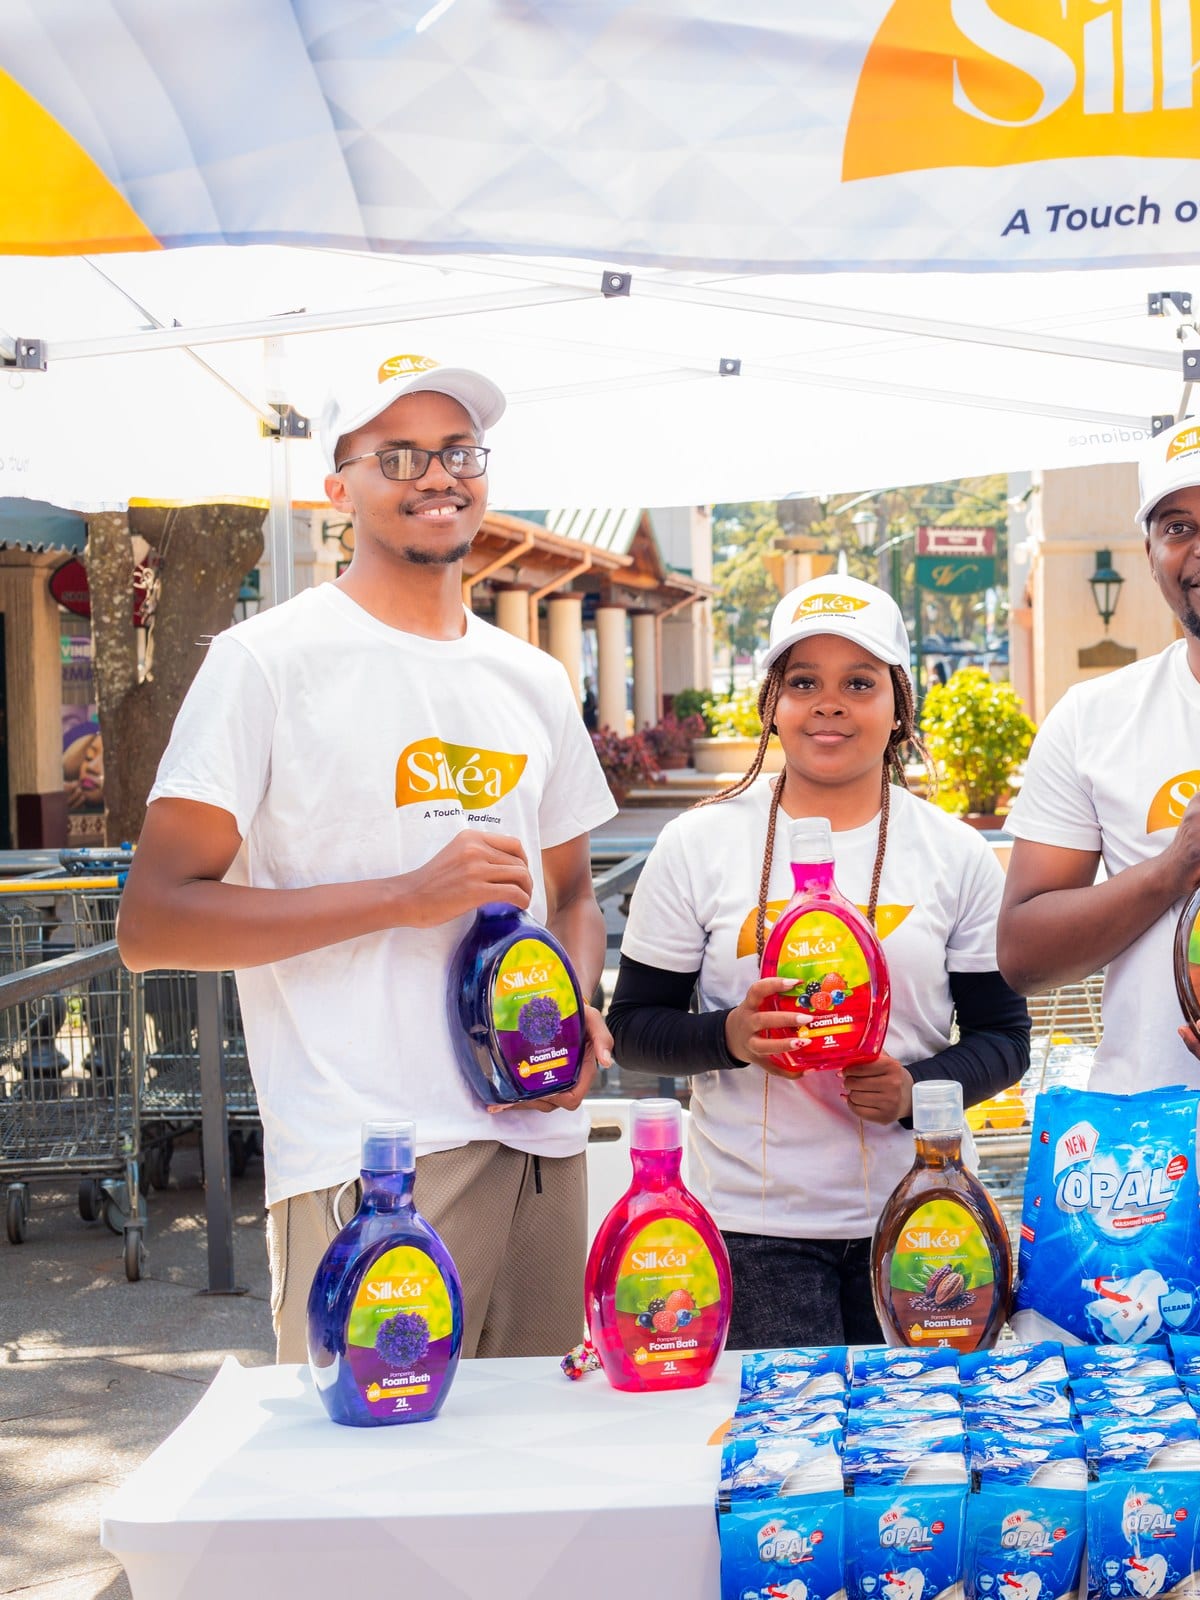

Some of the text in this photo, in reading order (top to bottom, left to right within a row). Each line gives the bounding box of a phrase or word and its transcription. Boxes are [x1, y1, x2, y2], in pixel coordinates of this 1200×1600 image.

[1001, 208, 1032, 238] A
[1046, 200, 1162, 235] Touch
[424, 808, 460, 819] A Touch
[787, 938, 836, 959] Silkéa
[502, 966, 549, 990] Silkéa
[833, 1014, 854, 1025] Bath
[824, 1035, 837, 1045] 2L
[530, 1047, 569, 1064] Foam Bath
[544, 1070, 556, 1082] 2L
[1064, 1134, 1088, 1157] NEW
[1062, 1166, 1176, 1211] OPAL
[905, 1230, 960, 1249] Silkéa
[631, 1249, 687, 1270] Silkéa
[366, 1280, 422, 1300] Silkéa
[1162, 1302, 1192, 1313] CLEANS
[924, 1317, 972, 1328] Foam Bath
[649, 1338, 698, 1351] Foam Bath
[938, 1338, 951, 1347] 2L
[664, 1361, 677, 1371] 2L
[382, 1373, 431, 1387] Foam Bath
[396, 1397, 409, 1409] 2L
[883, 1511, 898, 1524] NEW
[1006, 1514, 1022, 1526] NEW
[1126, 1513, 1176, 1531] OPAL
[761, 1525, 777, 1538] NEW
[882, 1526, 933, 1546] OPAL
[1003, 1530, 1055, 1549] OPAL
[761, 1537, 813, 1560] OPAL
